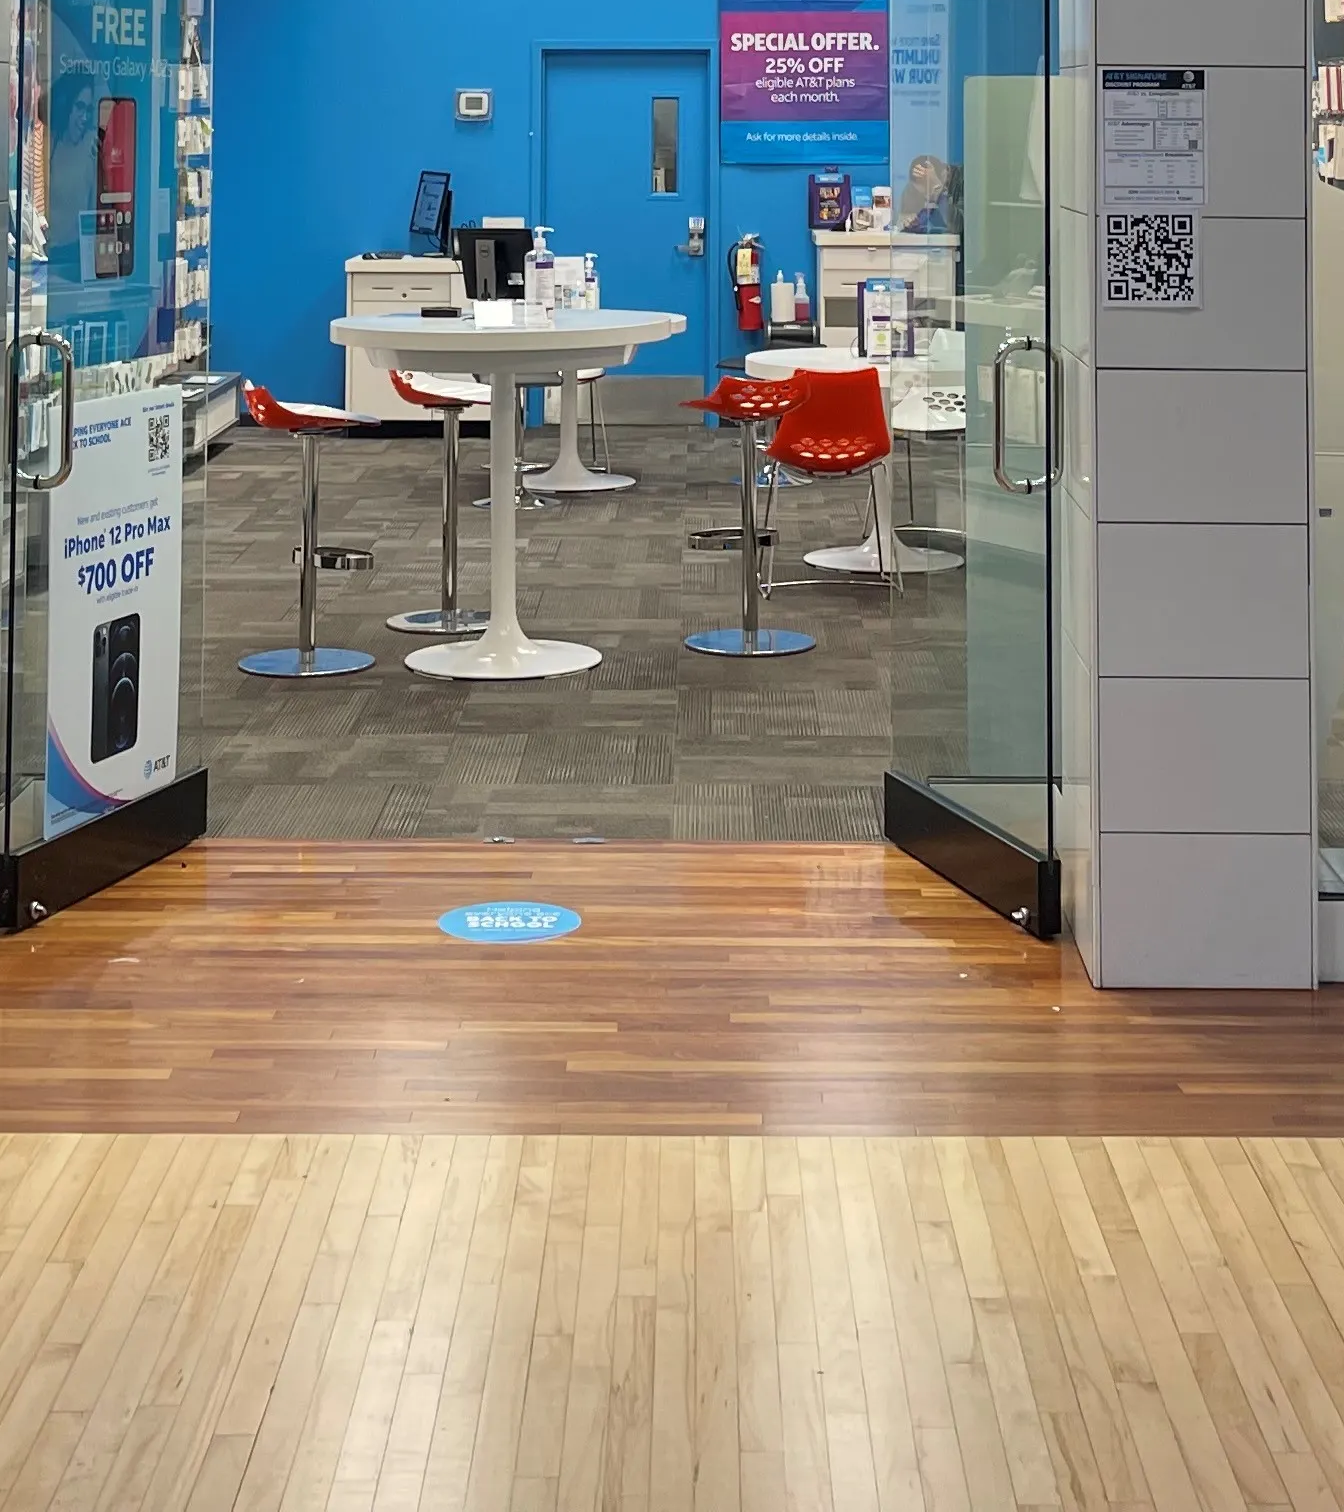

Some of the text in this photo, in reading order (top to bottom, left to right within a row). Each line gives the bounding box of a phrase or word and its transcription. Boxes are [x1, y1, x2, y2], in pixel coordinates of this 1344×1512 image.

[91, 5, 147, 47] FREE
[730, 32, 880, 52] SPECIAL OFFER.
[60, 53, 111, 80] Samsung
[112, 57, 148, 82] Galaxy
[765, 56, 845, 75] 25% OFF
[755, 76, 856, 92] eligible AT&T plans
[770, 90, 840, 104] each month.
[746, 131, 762, 142] Ask
[763, 131, 777, 142] for
[777, 133, 801, 142] more
[802, 131, 831, 142] details
[88, 433, 112, 447] SCHOOL
[90, 512, 100, 523] and
[101, 507, 122, 520] existing
[121, 500, 149, 515] customers
[64, 515, 171, 559] iPhone 12 Pro Max
[77, 547, 155, 595] $700 OFF
[153, 754, 171, 772] AT&T
